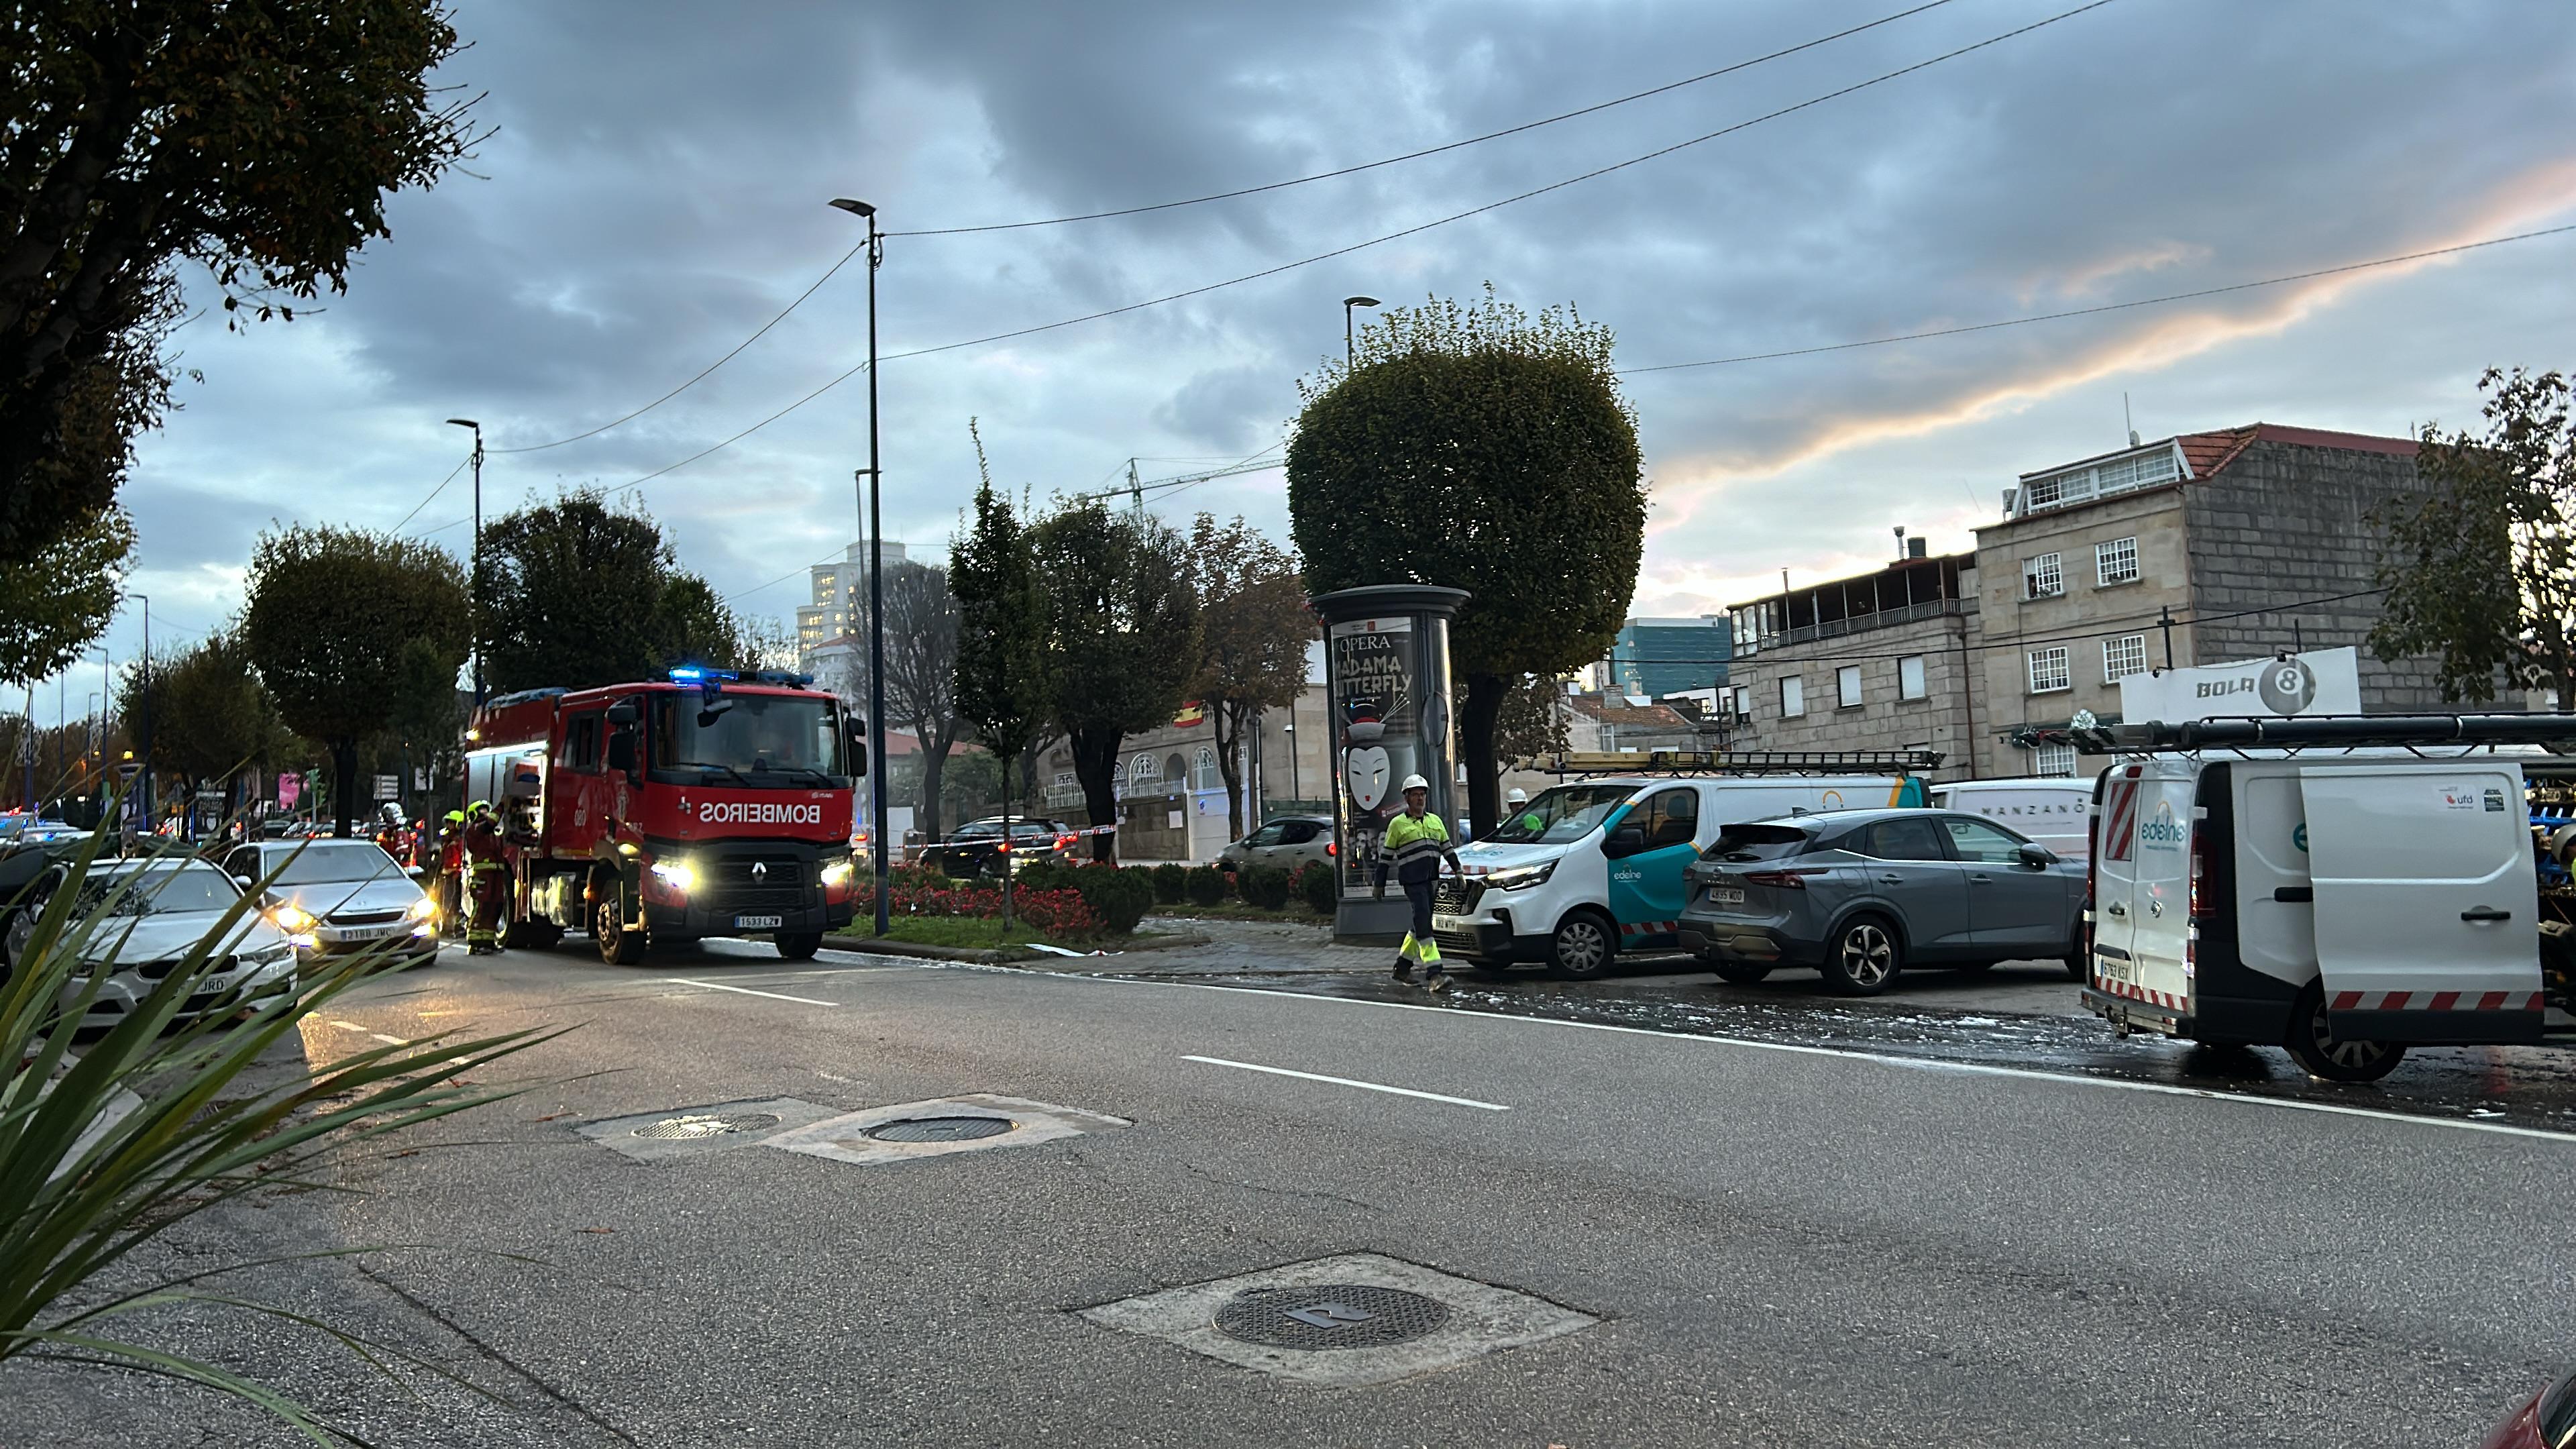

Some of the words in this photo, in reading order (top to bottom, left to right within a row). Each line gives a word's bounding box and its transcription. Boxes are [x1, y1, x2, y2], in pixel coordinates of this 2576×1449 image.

[2197, 678, 2255, 698] BOLA
[2279, 669, 2297, 691] 8
[2457, 795, 2473, 804] ufd
